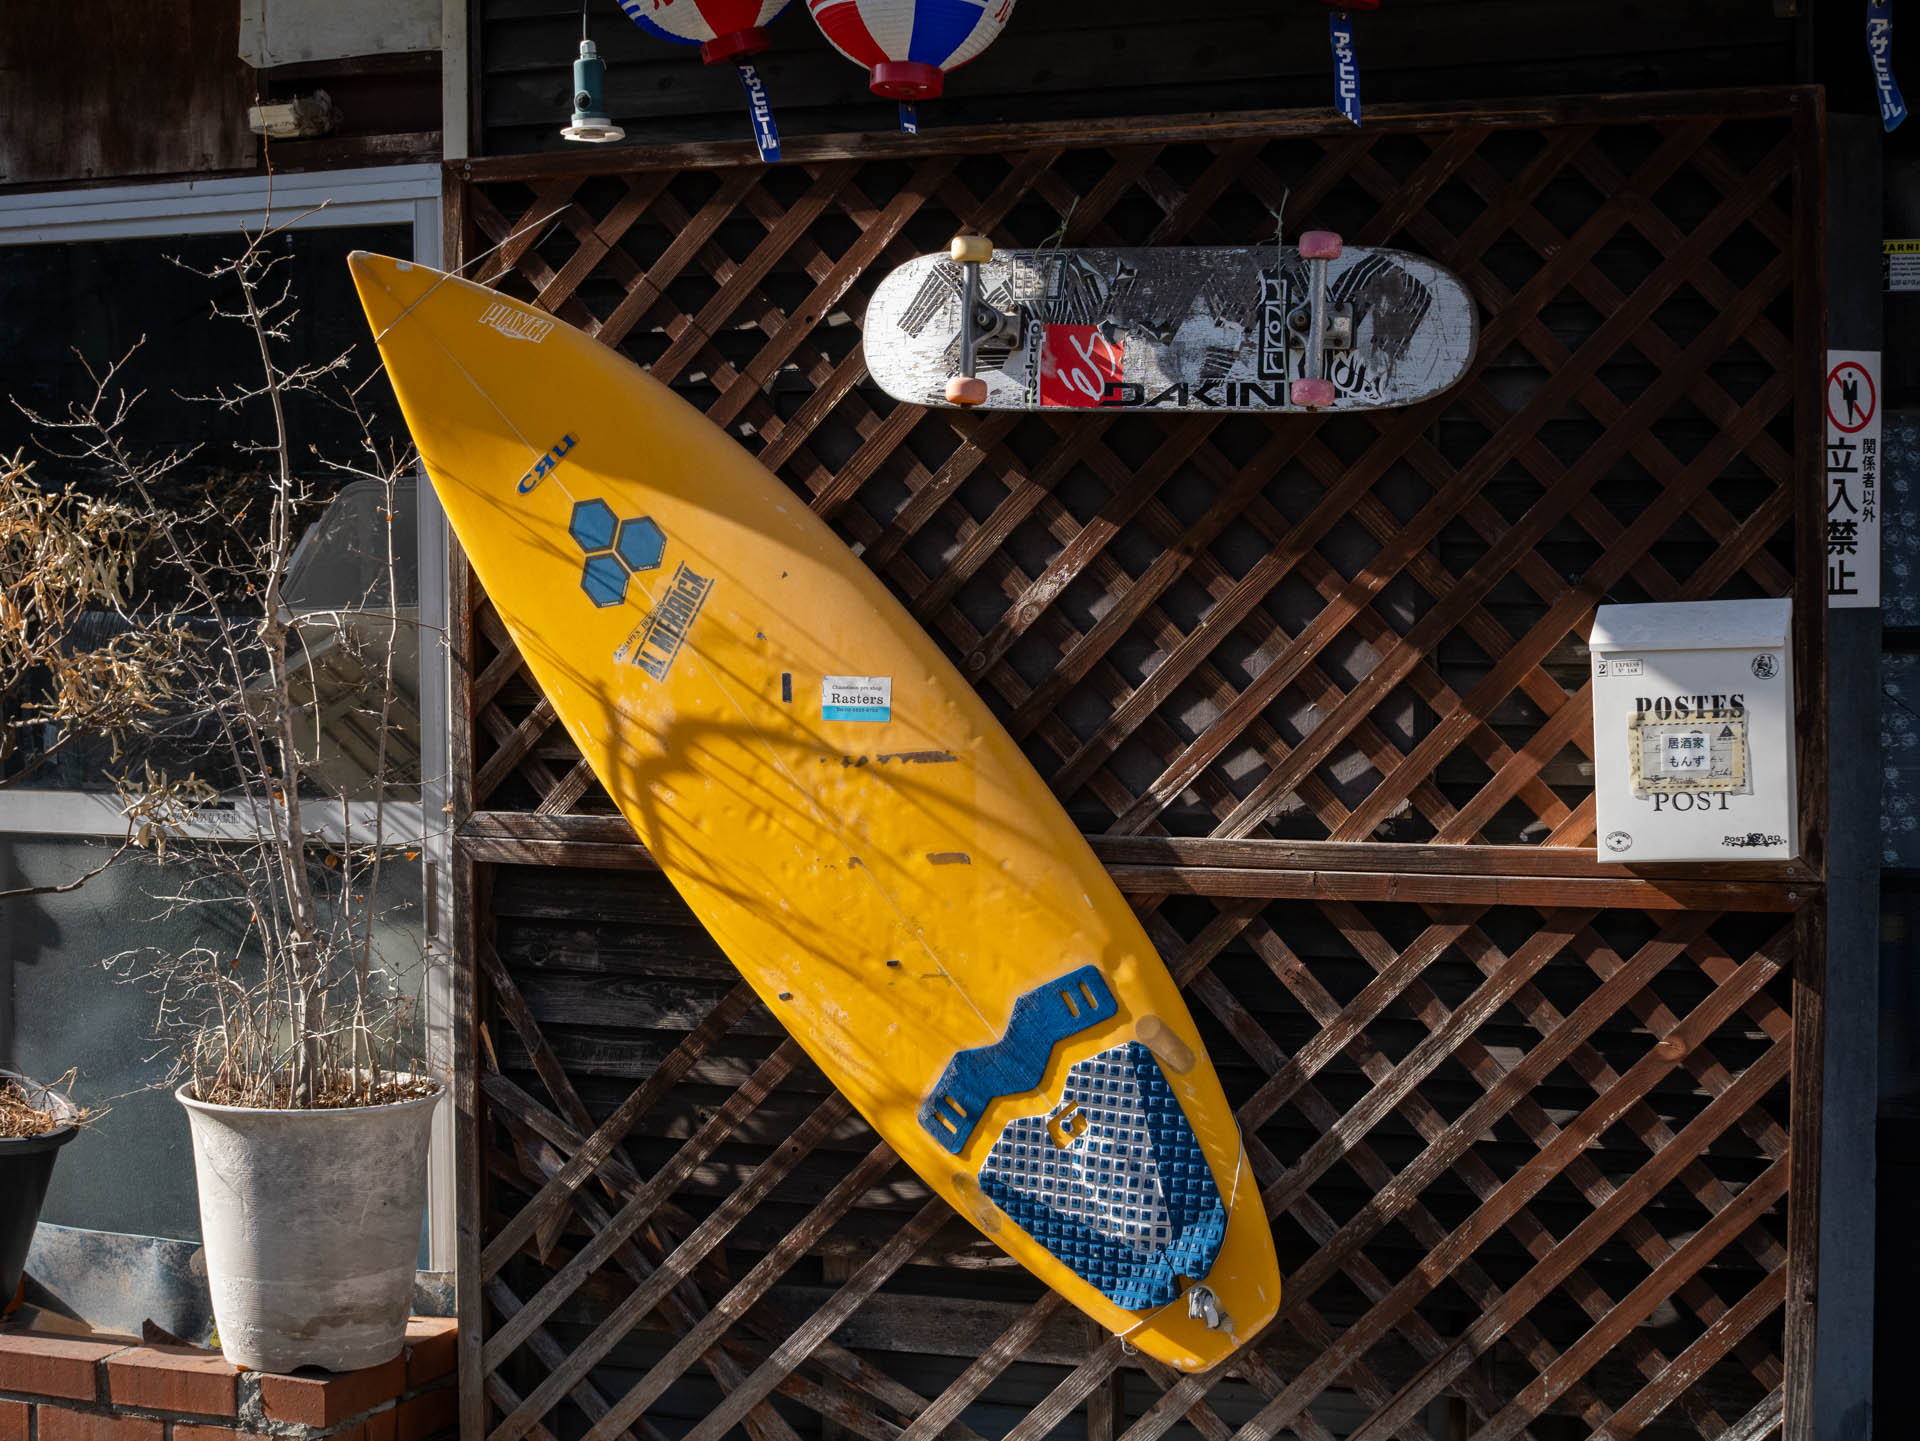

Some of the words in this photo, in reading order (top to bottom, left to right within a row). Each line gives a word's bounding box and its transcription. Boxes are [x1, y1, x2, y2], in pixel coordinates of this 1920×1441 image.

[1870, 18, 1903, 120] アサヒビール
[1099, 382, 1338, 406] DAKIN
[1861, 437, 1877, 523] 関係者以外
[1827, 437, 1859, 596] 立入禁止
[831, 693, 884, 704] Rasters
[1635, 694, 1745, 720] POSTES
[1652, 791, 1732, 811] POST
